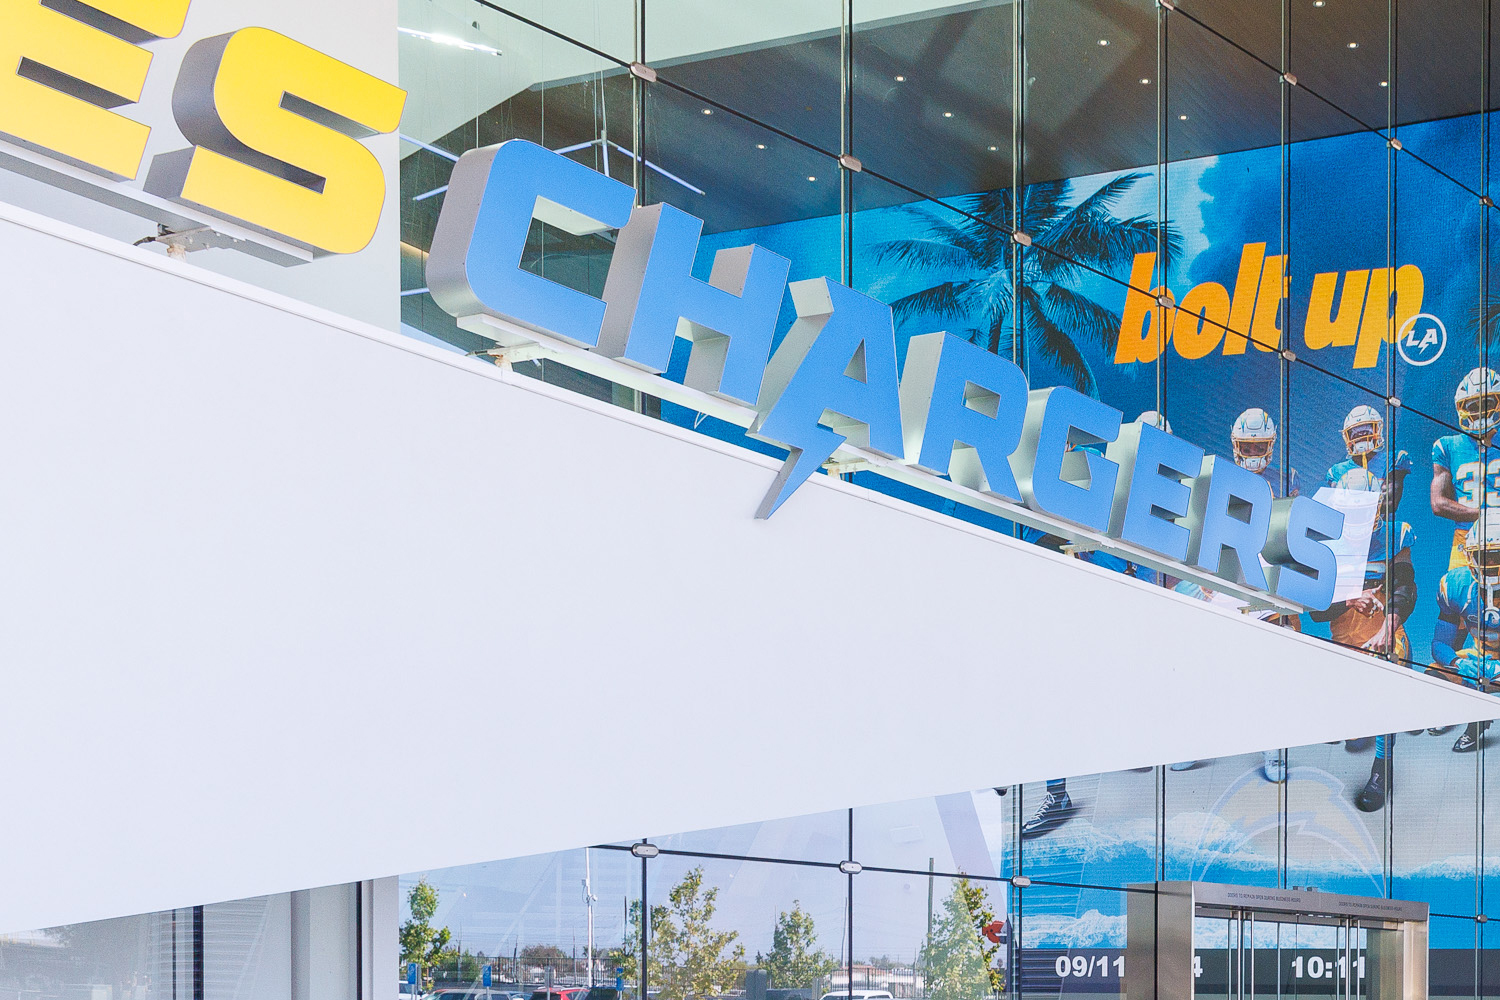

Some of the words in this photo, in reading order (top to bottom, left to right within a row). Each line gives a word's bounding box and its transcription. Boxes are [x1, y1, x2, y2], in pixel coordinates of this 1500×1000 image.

[1114, 242, 1292, 364] bolt
[1304, 264, 1424, 369] up
[1405, 328, 1438, 355] LA
[427, 138, 1346, 613] CHARGERS
[1291, 955, 1366, 978] 10:11
